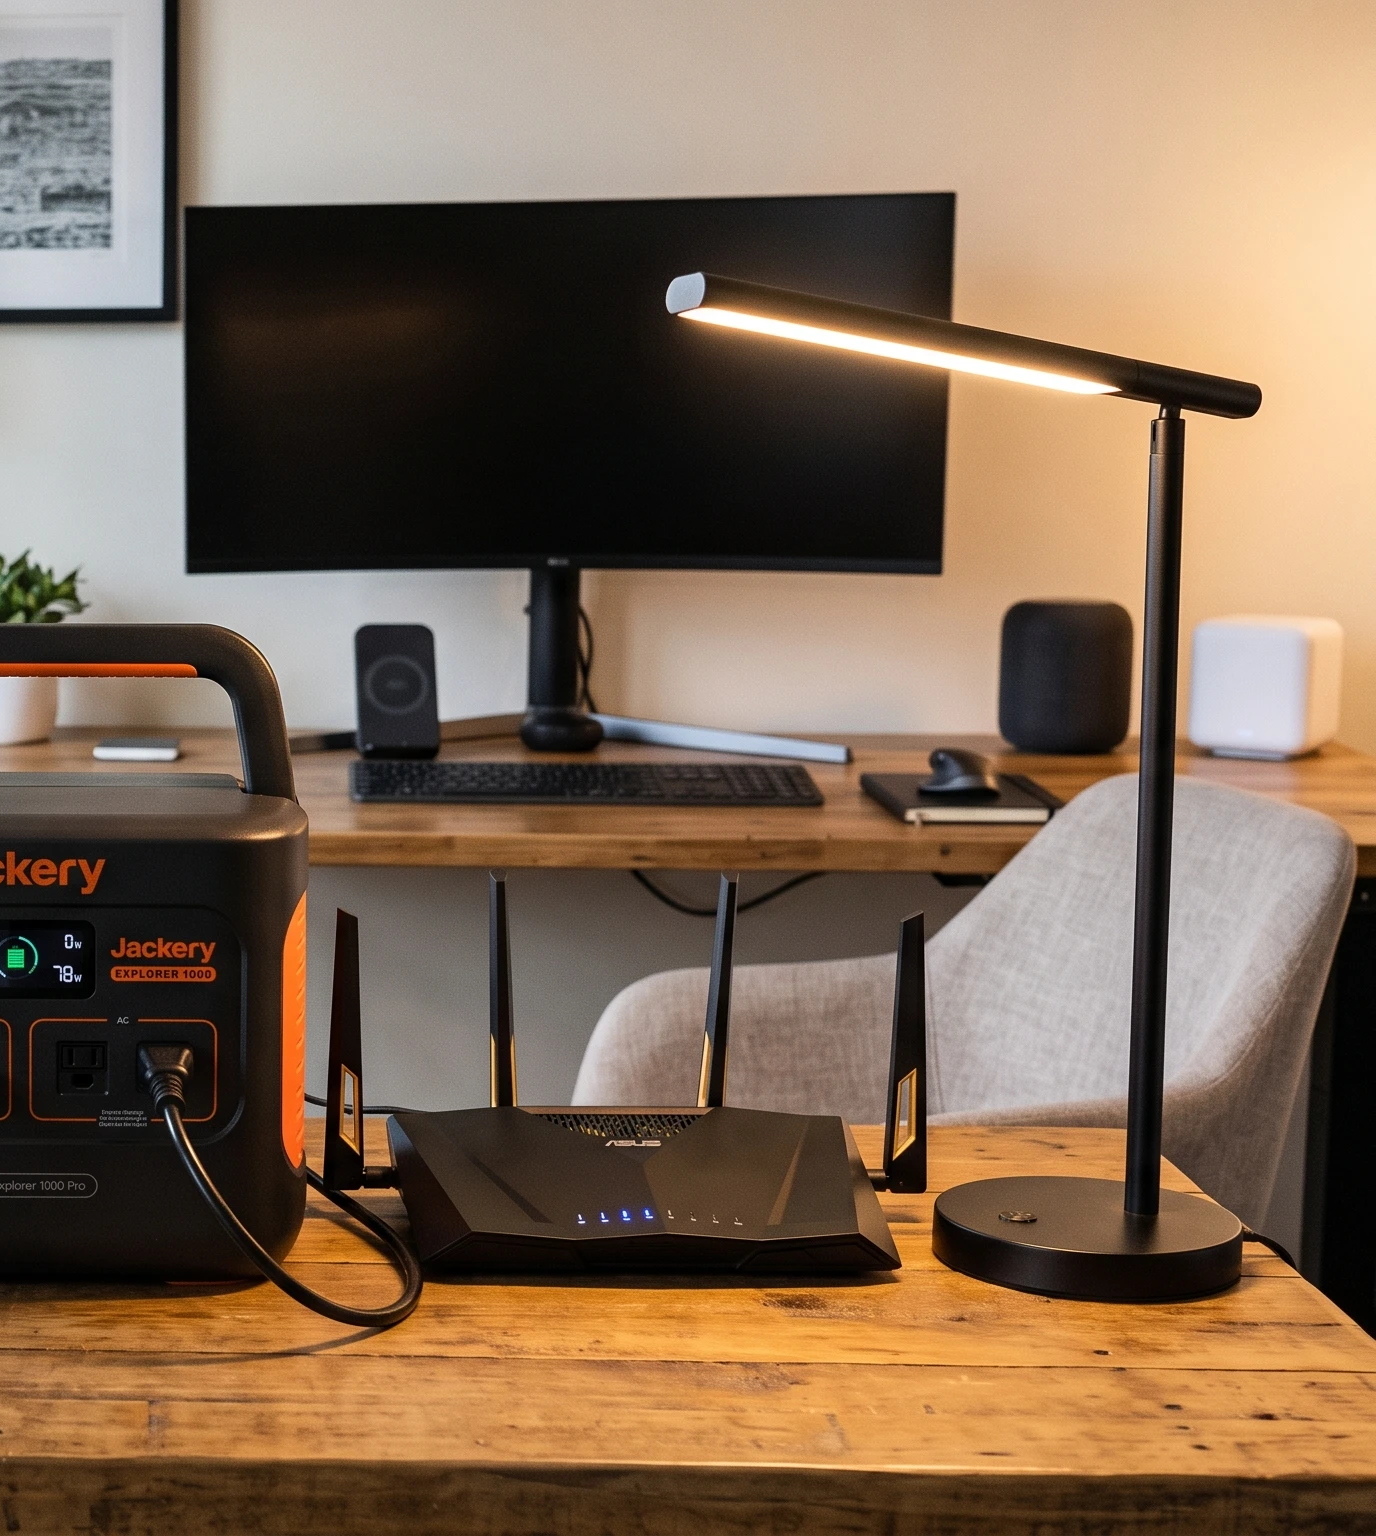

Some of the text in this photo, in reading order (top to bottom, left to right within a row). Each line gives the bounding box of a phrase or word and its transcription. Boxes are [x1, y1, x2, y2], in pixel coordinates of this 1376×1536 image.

[110, 937, 217, 964] Jackery
[115, 969, 212, 979] EXPLORER 1000
[116, 1016, 130, 1025] AC
[604, 1139, 662, 1147] ASUS
[39, 1180, 65, 1191] 1000
[67, 1180, 86, 1191] Pro
